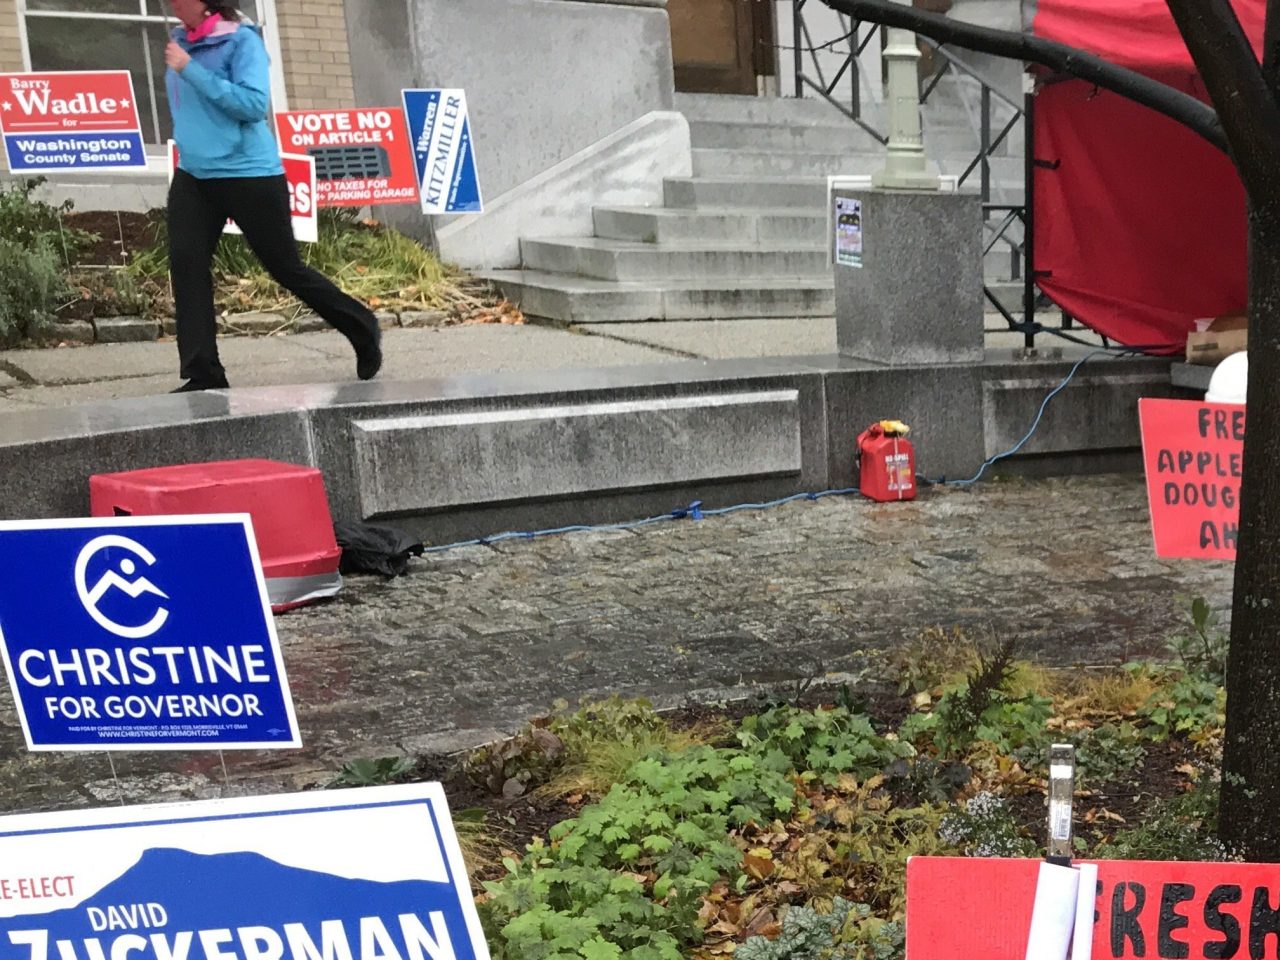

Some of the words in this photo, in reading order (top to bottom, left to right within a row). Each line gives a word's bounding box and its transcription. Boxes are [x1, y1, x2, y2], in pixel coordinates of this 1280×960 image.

[10, 78, 50, 89] Barry
[12, 89, 117, 115] Wadle
[62, 118, 78, 126] for
[288, 113, 352, 132] VOTE
[358, 111, 391, 129] NO
[16, 139, 131, 152] Washington
[291, 133, 314, 146] ON
[319, 130, 382, 145] ARTICLE
[386, 130, 394, 142] 1
[24, 153, 76, 164] County
[81, 152, 130, 162] Senate
[425, 95, 461, 207] KITZMILLER
[317, 181, 331, 191] NO
[335, 180, 365, 191] TAXES
[367, 179, 388, 188] FOR
[327, 189, 372, 201] PARKING
[373, 187, 415, 199] GARAGE
[1198, 408, 1245, 441] FRE
[1158, 449, 1242, 477] APPLE
[18, 644, 271, 687] CHRISTINE
[44, 696, 102, 719] FOR
[104, 693, 264, 718] GOVERNOR
[98, 730, 219, 738] WWW.CHRISTINEFORVERMONT.COM
[0, 876, 74, 899] E-ELECT
[87, 903, 168, 932] DAVID
